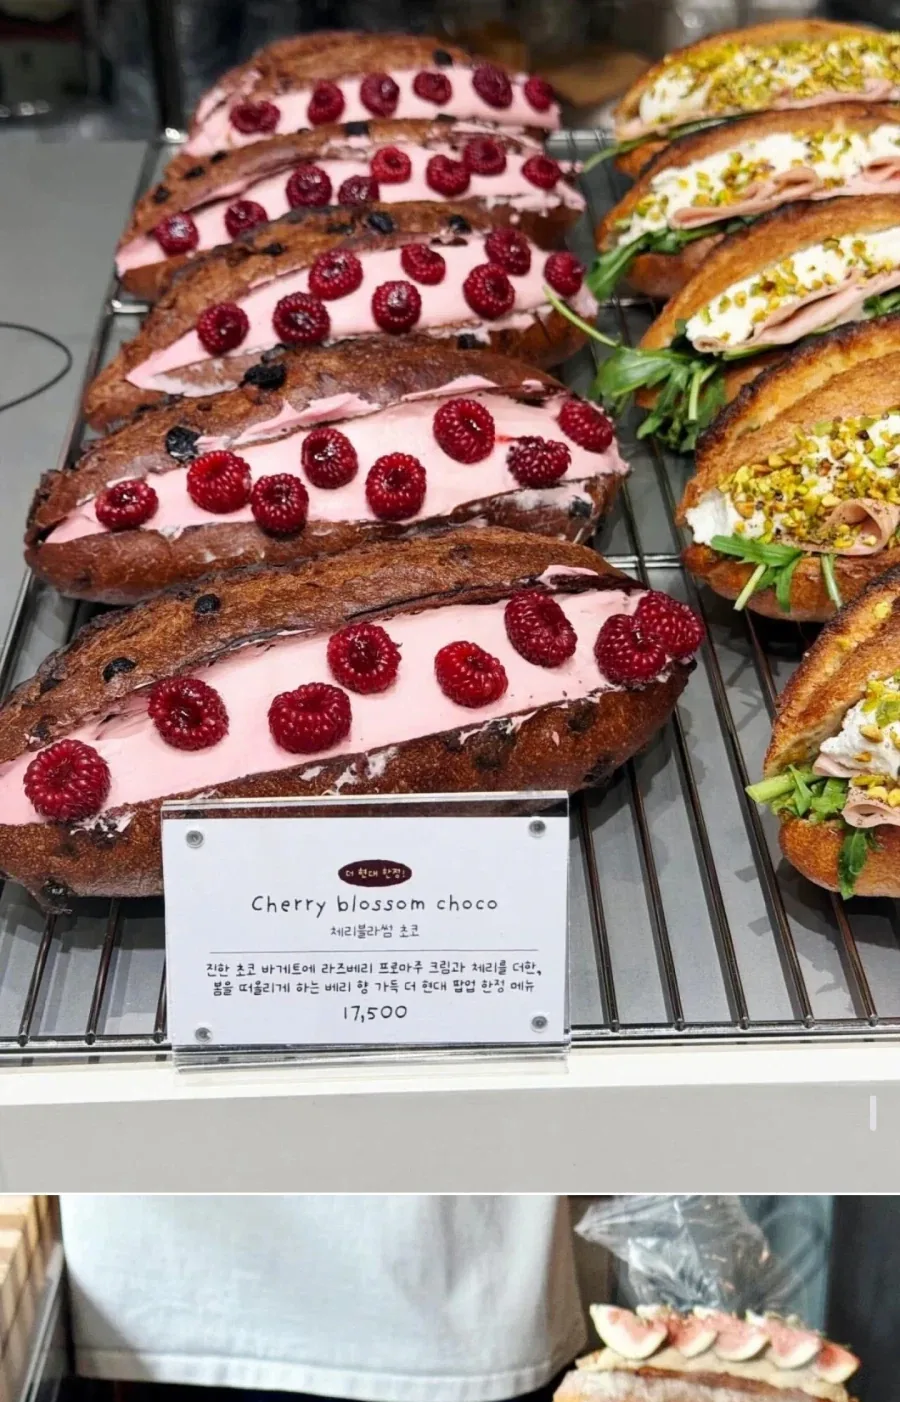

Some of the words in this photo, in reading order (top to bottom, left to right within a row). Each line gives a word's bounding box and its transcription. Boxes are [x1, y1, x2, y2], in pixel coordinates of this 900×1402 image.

[345, 869, 354, 878] 더
[358, 867, 378, 879] 현대
[251, 895, 326, 918] Cherry
[337, 894, 425, 912] blossom
[436, 894, 499, 911] choco
[330, 923, 393, 939] 체리블라썸
[399, 924, 420, 938] 초코
[206, 963, 230, 977] 진한
[236, 963, 256, 977] 초코
[261, 963, 316, 975] 바게트에
[321, 962, 373, 975] 라즈베리
[378, 960, 423, 975] 프로마주
[428, 960, 466, 975] 크림과
[471, 960, 507, 975] 체리를
[213, 981, 234, 997] 봄을
[238, 980, 290, 996] 떠올리게
[296, 981, 319, 994] 하는
[324, 981, 351, 993] 베리
[357, 980, 369, 994] 향
[375, 979, 399, 993] 가득
[404, 981, 416, 991] 더
[421, 979, 447, 993] 현대
[453, 979, 476, 993] 팝업
[481, 979, 505, 993] 한정
[510, 980, 535, 992] 메뉴
[344, 1005, 408, 1023] 17,500
